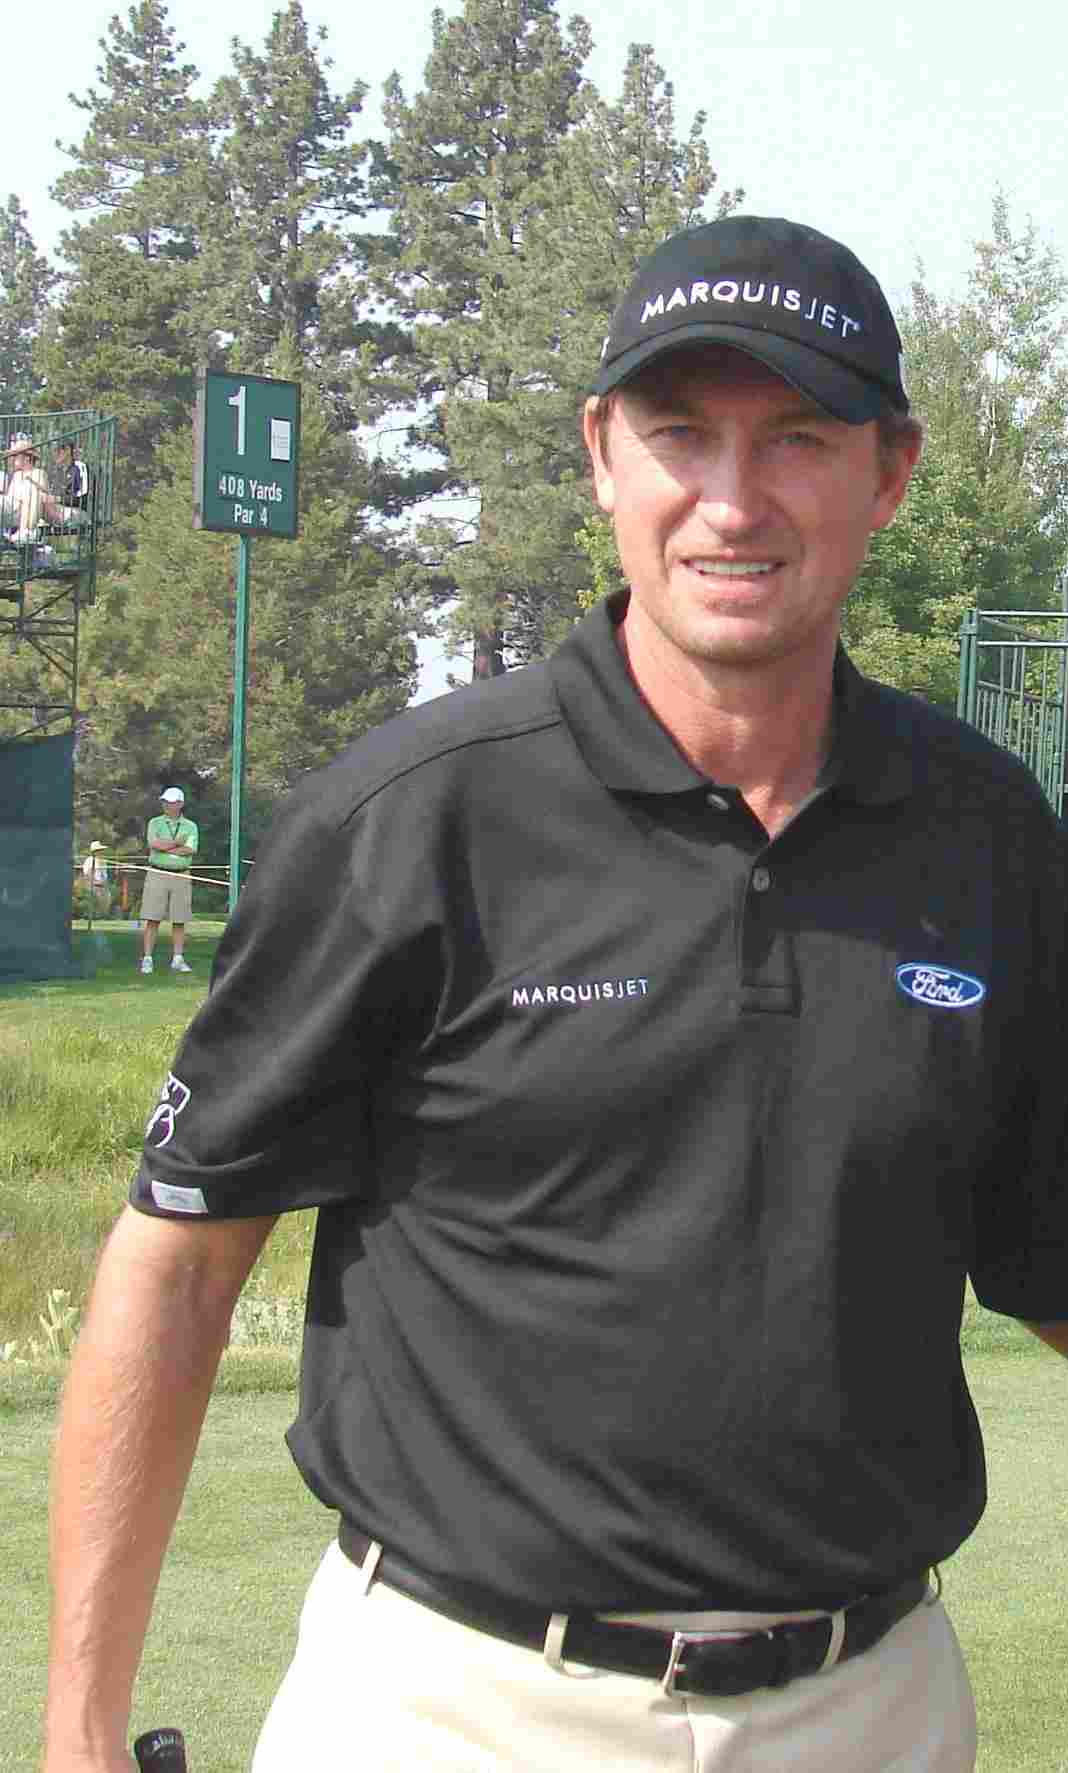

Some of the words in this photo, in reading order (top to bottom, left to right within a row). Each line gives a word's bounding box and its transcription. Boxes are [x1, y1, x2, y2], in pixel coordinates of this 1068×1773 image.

[228, 385, 247, 456] 1
[218, 475, 245, 498] 408
[249, 479, 283, 502] Yards
[234, 503, 254, 524] Par
[259, 506, 269, 527] 4
[911, 969, 963, 1002] Ford
